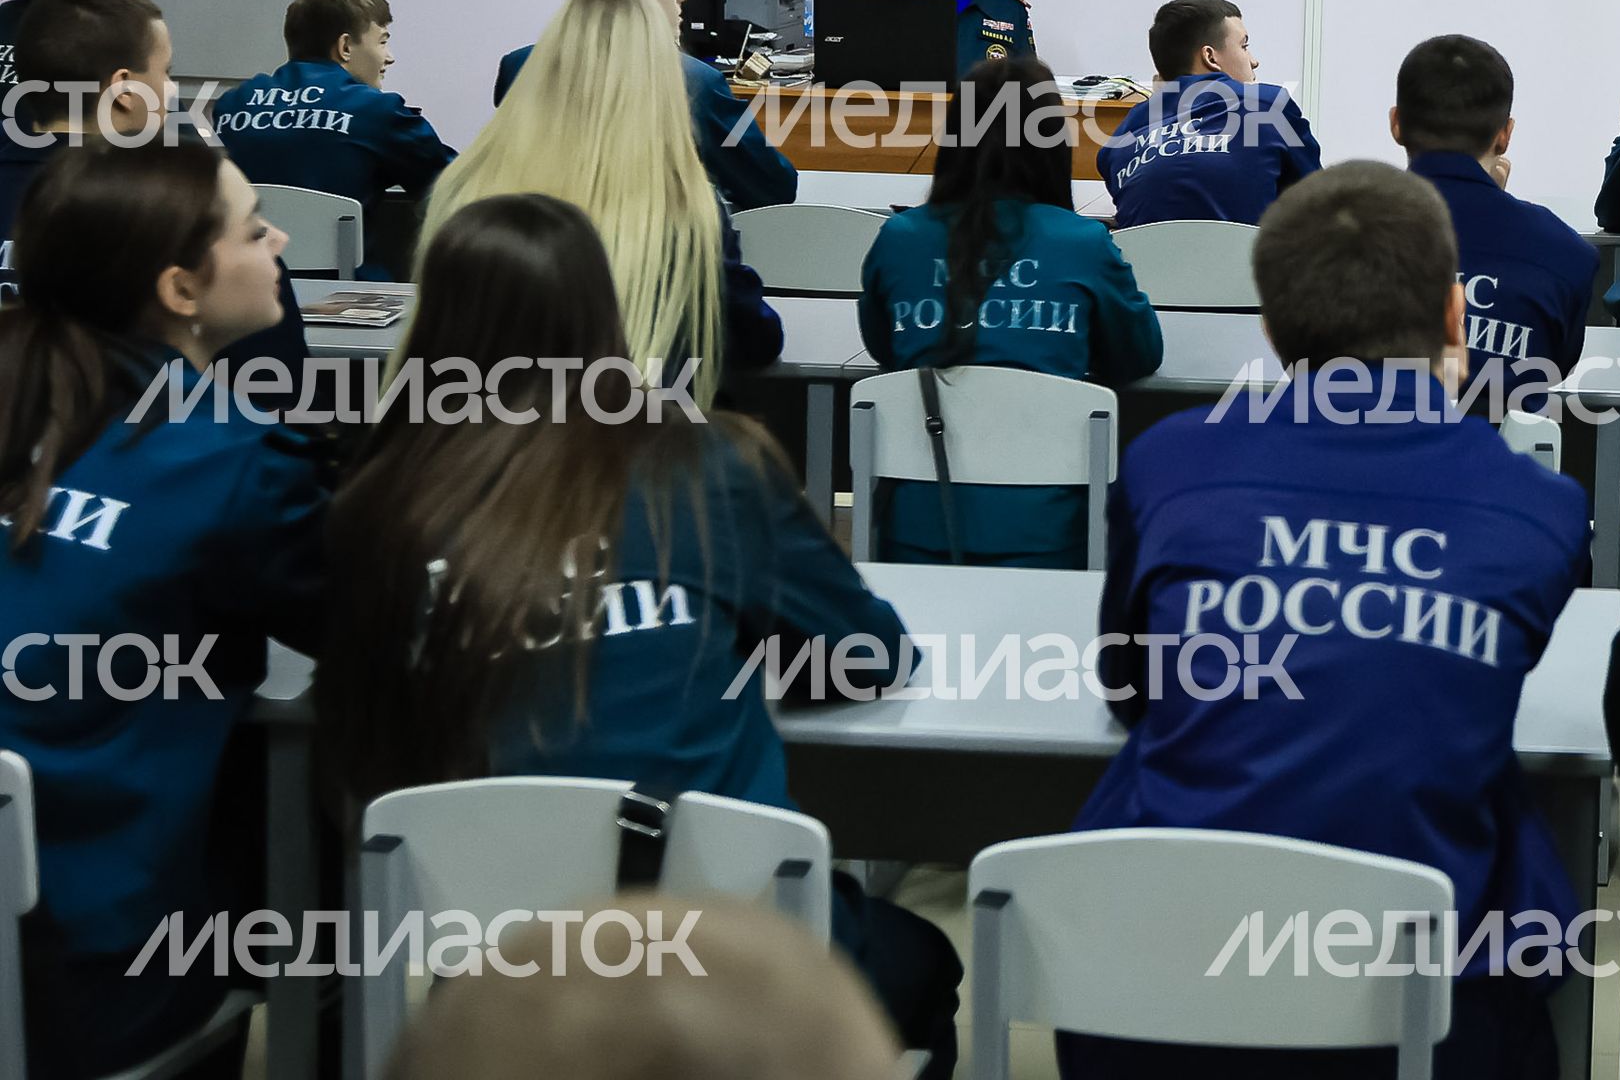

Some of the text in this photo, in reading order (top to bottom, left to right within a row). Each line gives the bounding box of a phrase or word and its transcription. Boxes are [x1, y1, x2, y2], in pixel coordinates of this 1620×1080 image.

[246, 86, 325, 107] МЧС
[217, 107, 353, 135] РОССИИ
[1133, 118, 1204, 155] МЧС
[1116, 134, 1231, 190] РОССИИ
[893, 298, 1079, 334] РОСИИ
[1257, 515, 1447, 580] МЧС
[1181, 574, 1502, 668] РОССИИ
